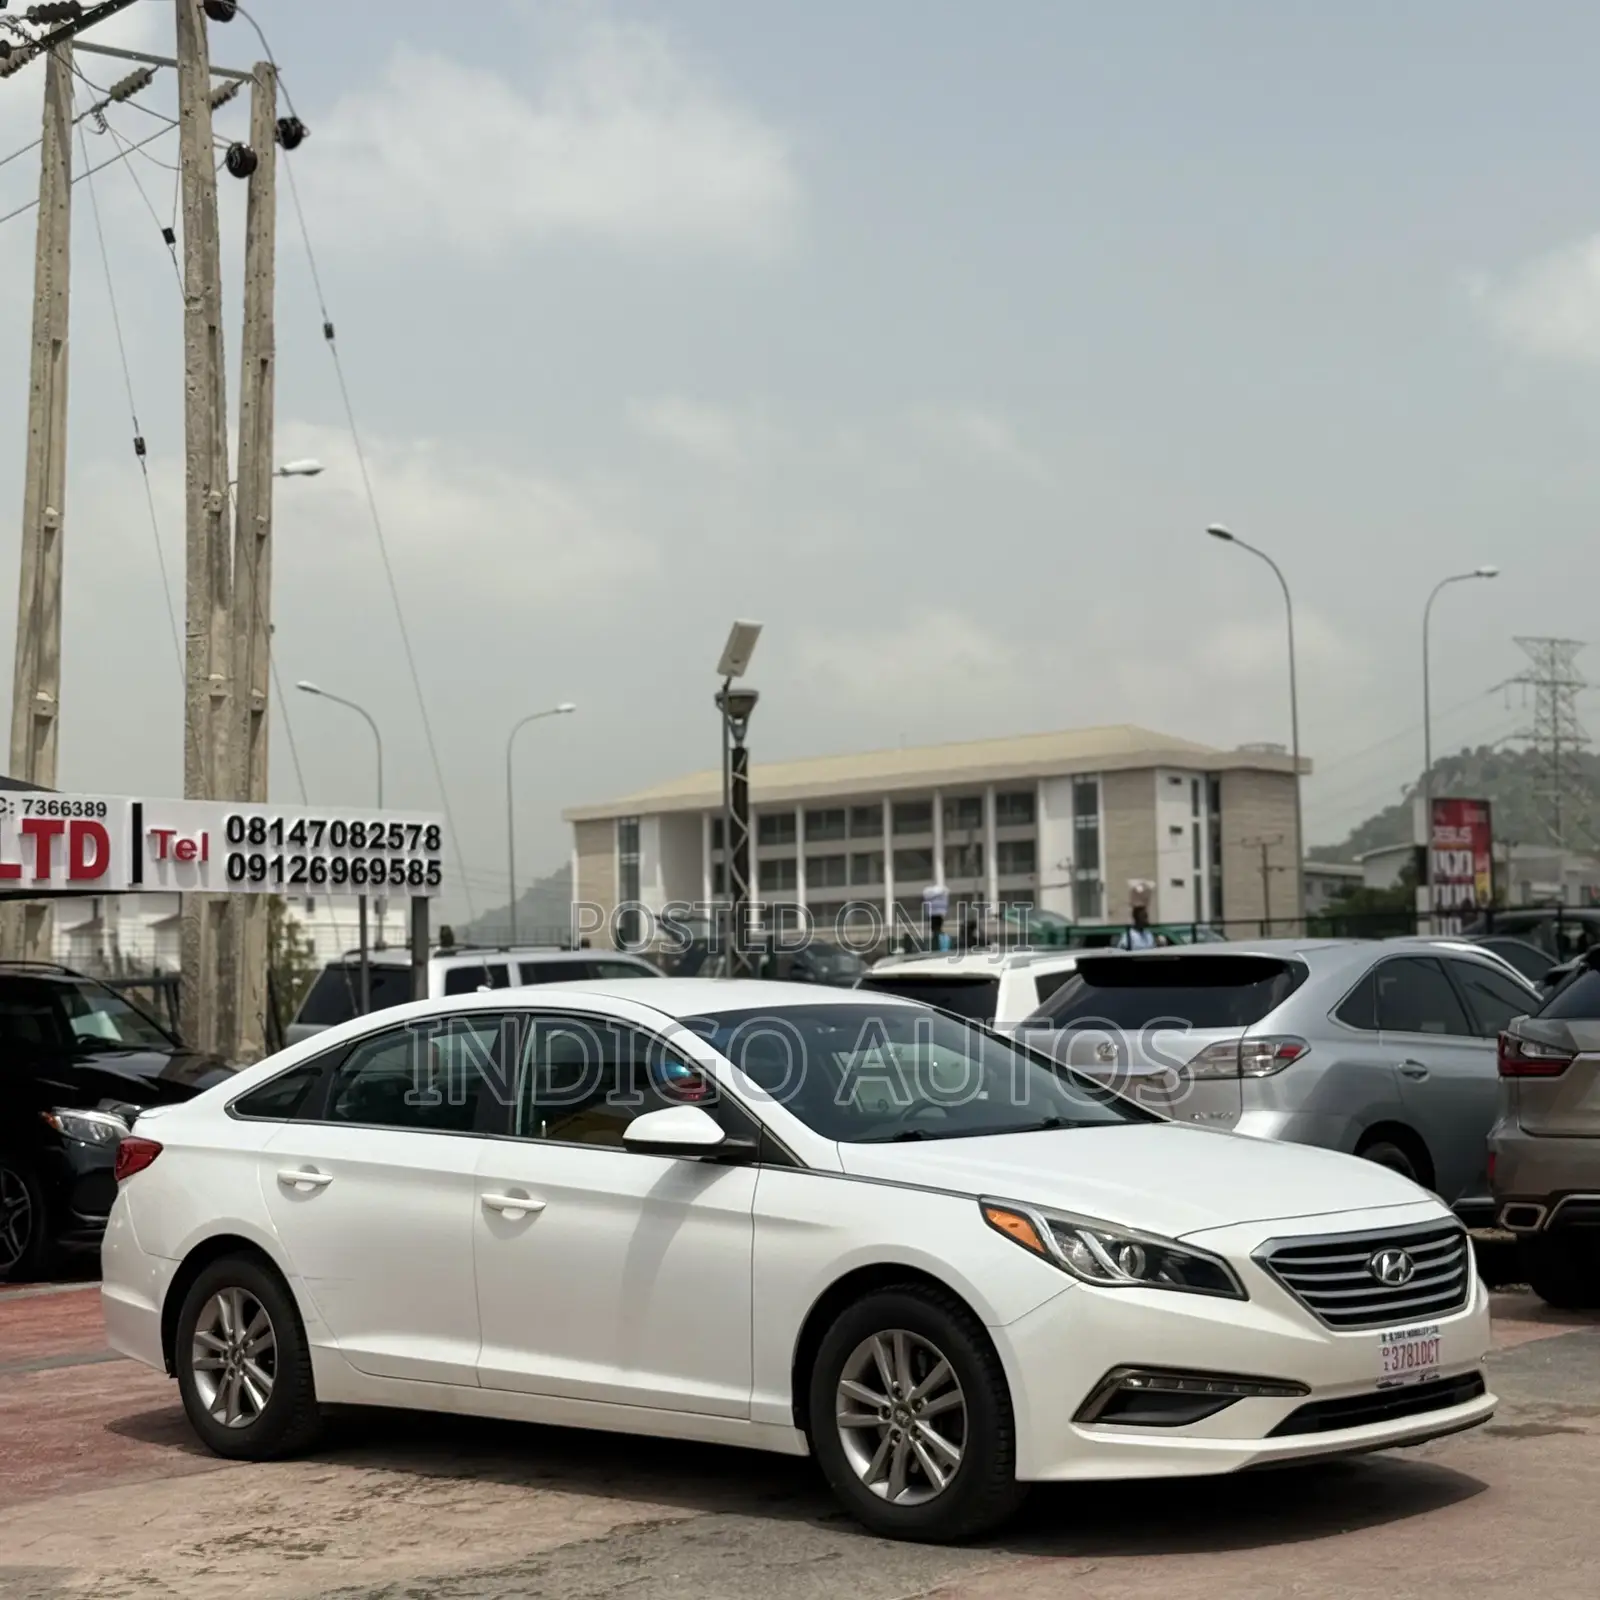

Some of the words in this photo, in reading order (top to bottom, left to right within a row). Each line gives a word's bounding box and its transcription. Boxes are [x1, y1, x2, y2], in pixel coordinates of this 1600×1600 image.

[22, 799, 107, 817] 7366389
[150, 829, 208, 861] Tel
[226, 815, 440, 851] 08147082578
[227, 852, 442, 886] 09126969585
